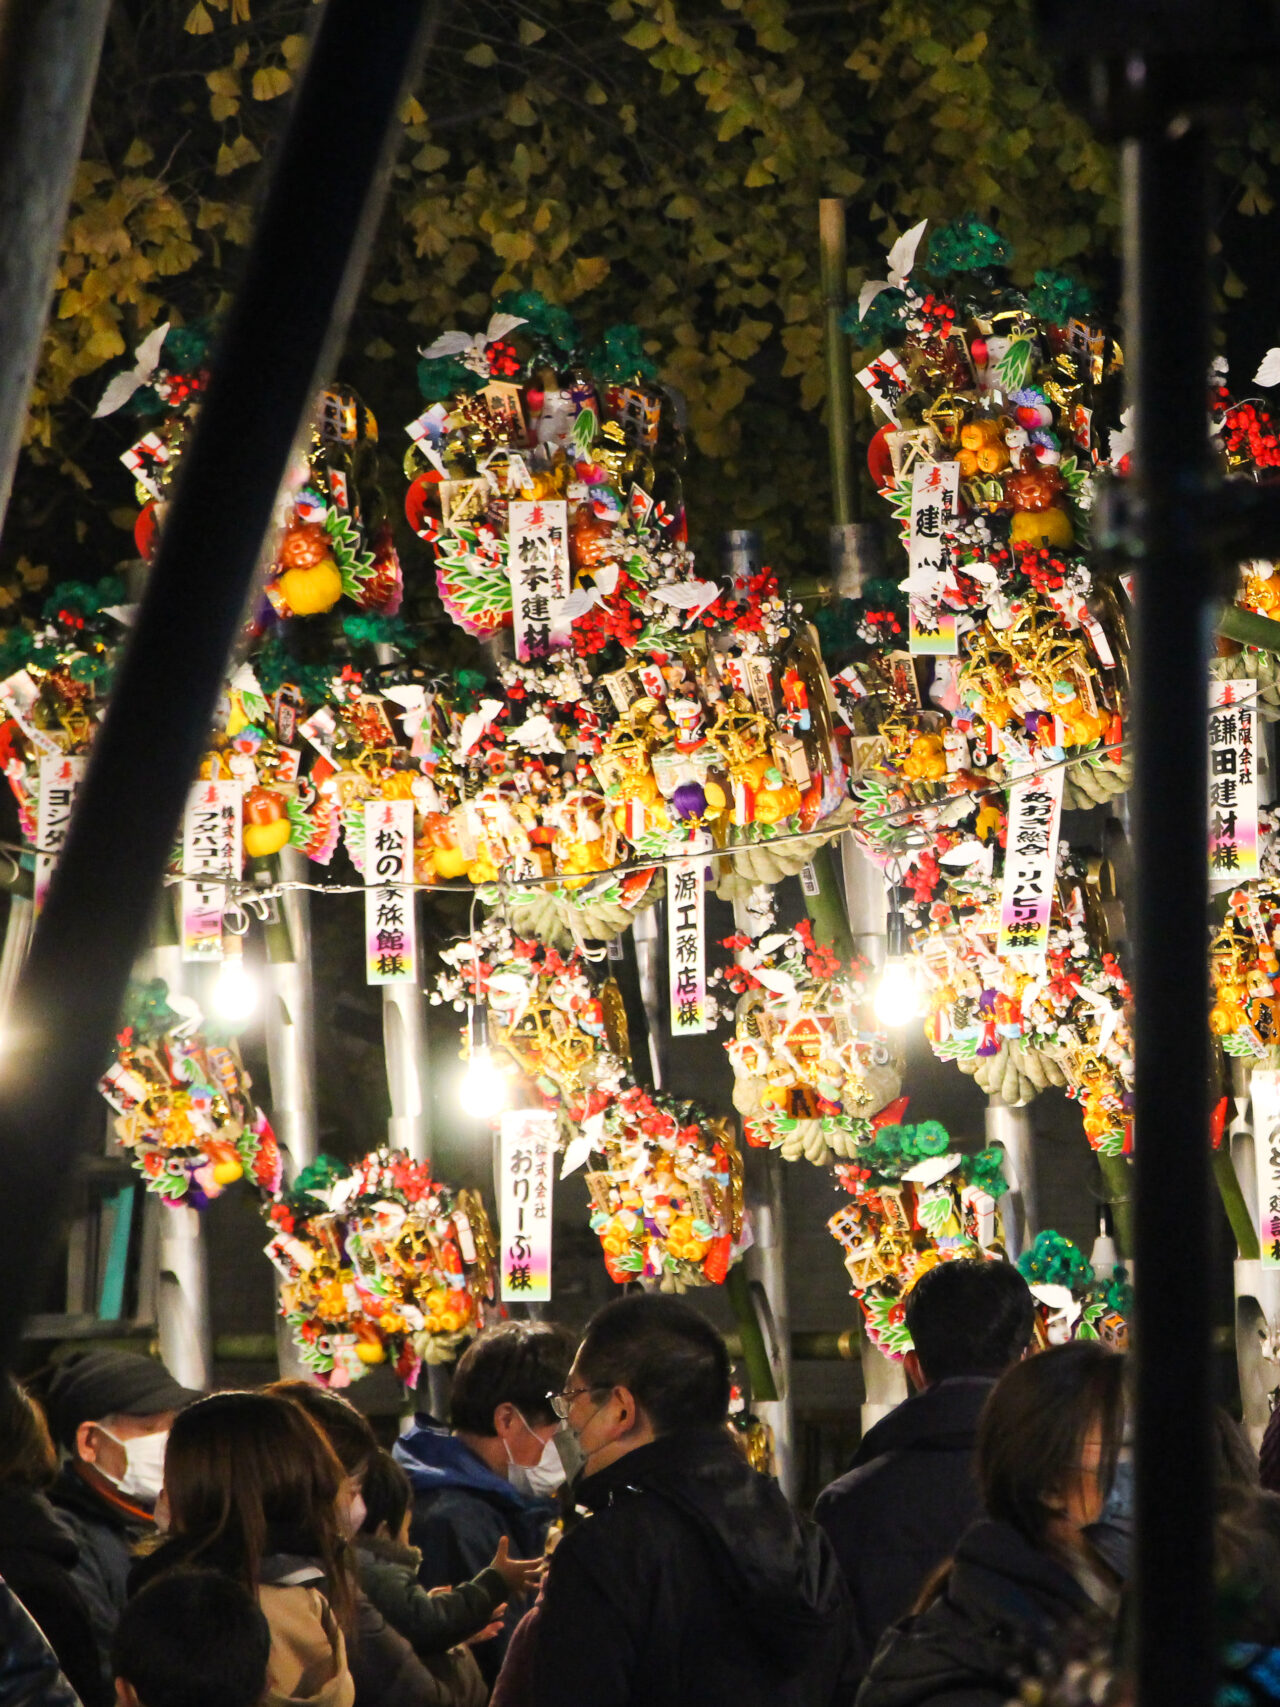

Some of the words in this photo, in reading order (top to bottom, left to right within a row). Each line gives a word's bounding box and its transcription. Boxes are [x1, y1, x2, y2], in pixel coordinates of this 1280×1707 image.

[517, 535, 552, 651] 松本建材
[1208, 714, 1240, 871] 鎌田建材様
[1238, 708, 1254, 786] 有限会社
[674, 870, 700, 1027] 源工務店様
[508, 1148, 533, 1292] おりーぶ様
